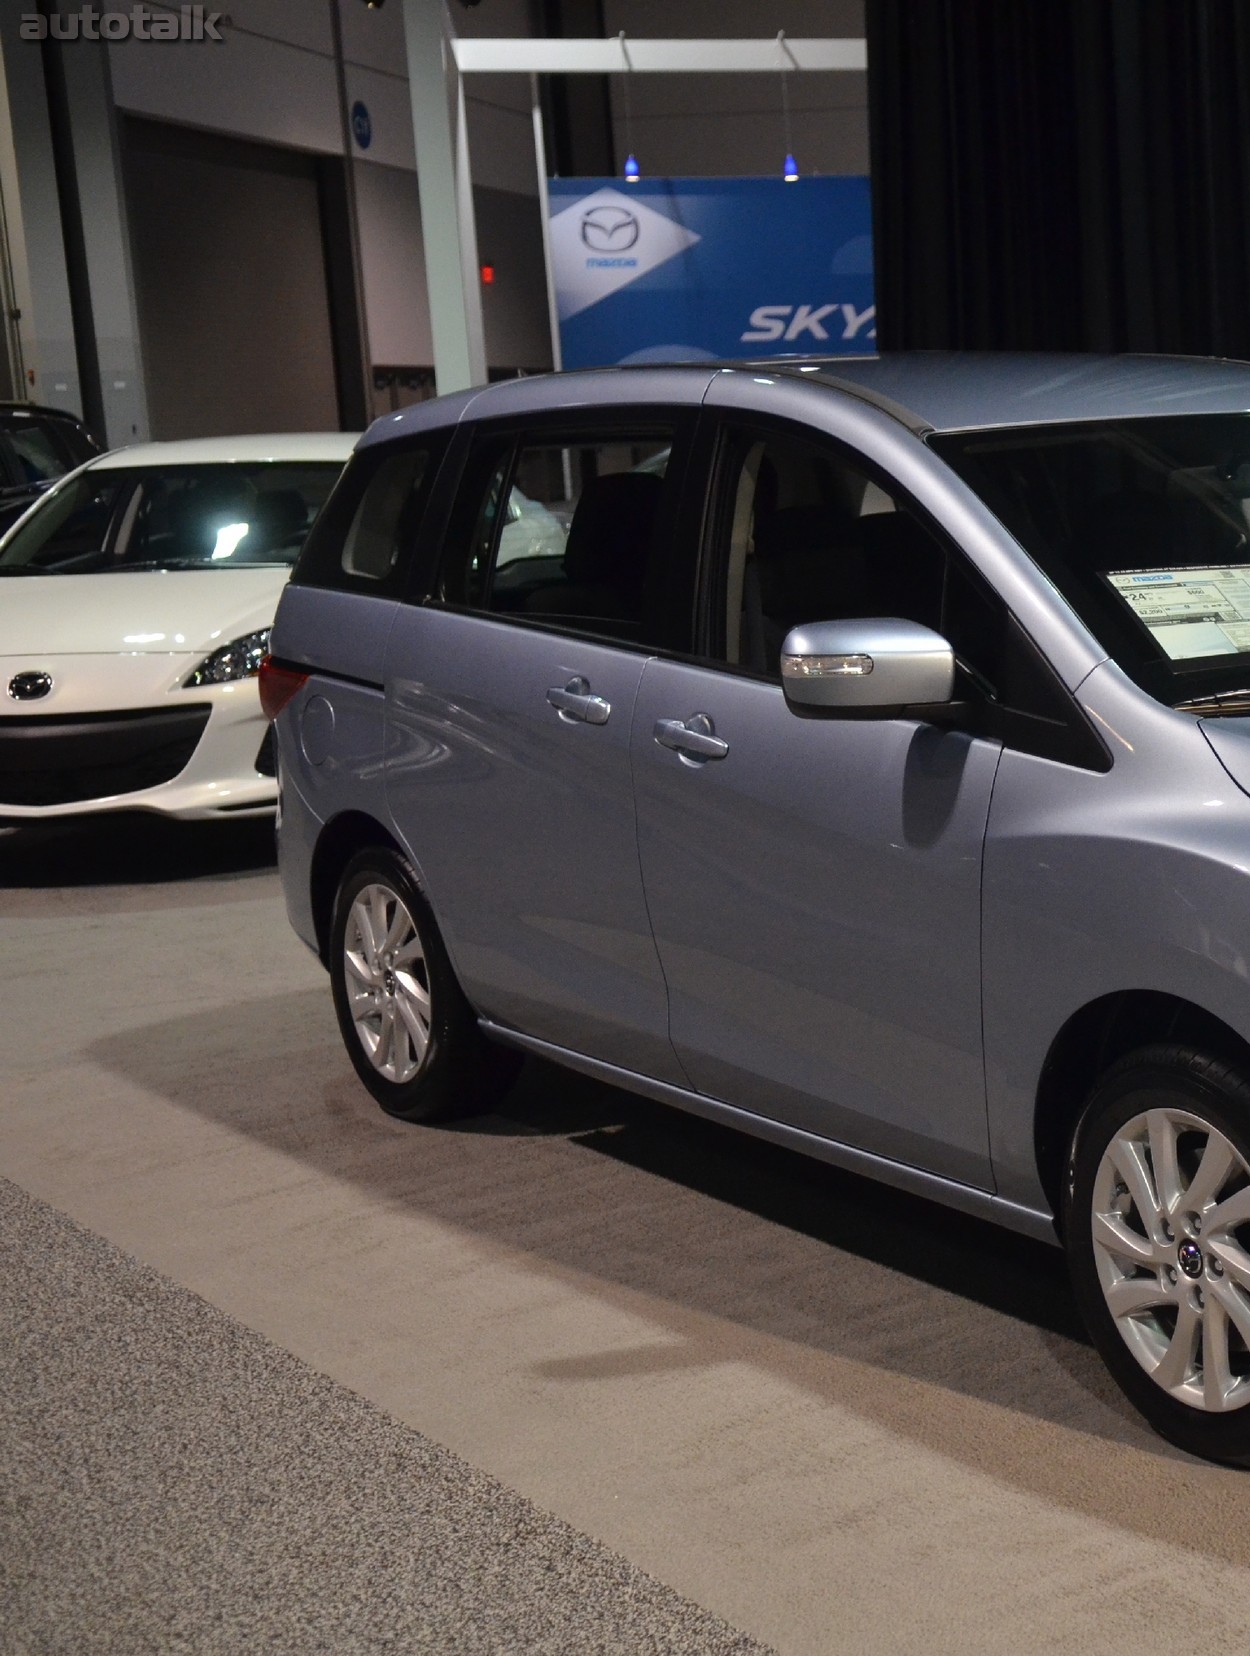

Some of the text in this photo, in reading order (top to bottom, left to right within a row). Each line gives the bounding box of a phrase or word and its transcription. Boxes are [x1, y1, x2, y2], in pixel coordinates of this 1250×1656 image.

[585, 256, 638, 269] mazda
[740, 303, 876, 342] SKY
[1132, 574, 1174, 583] mazda
